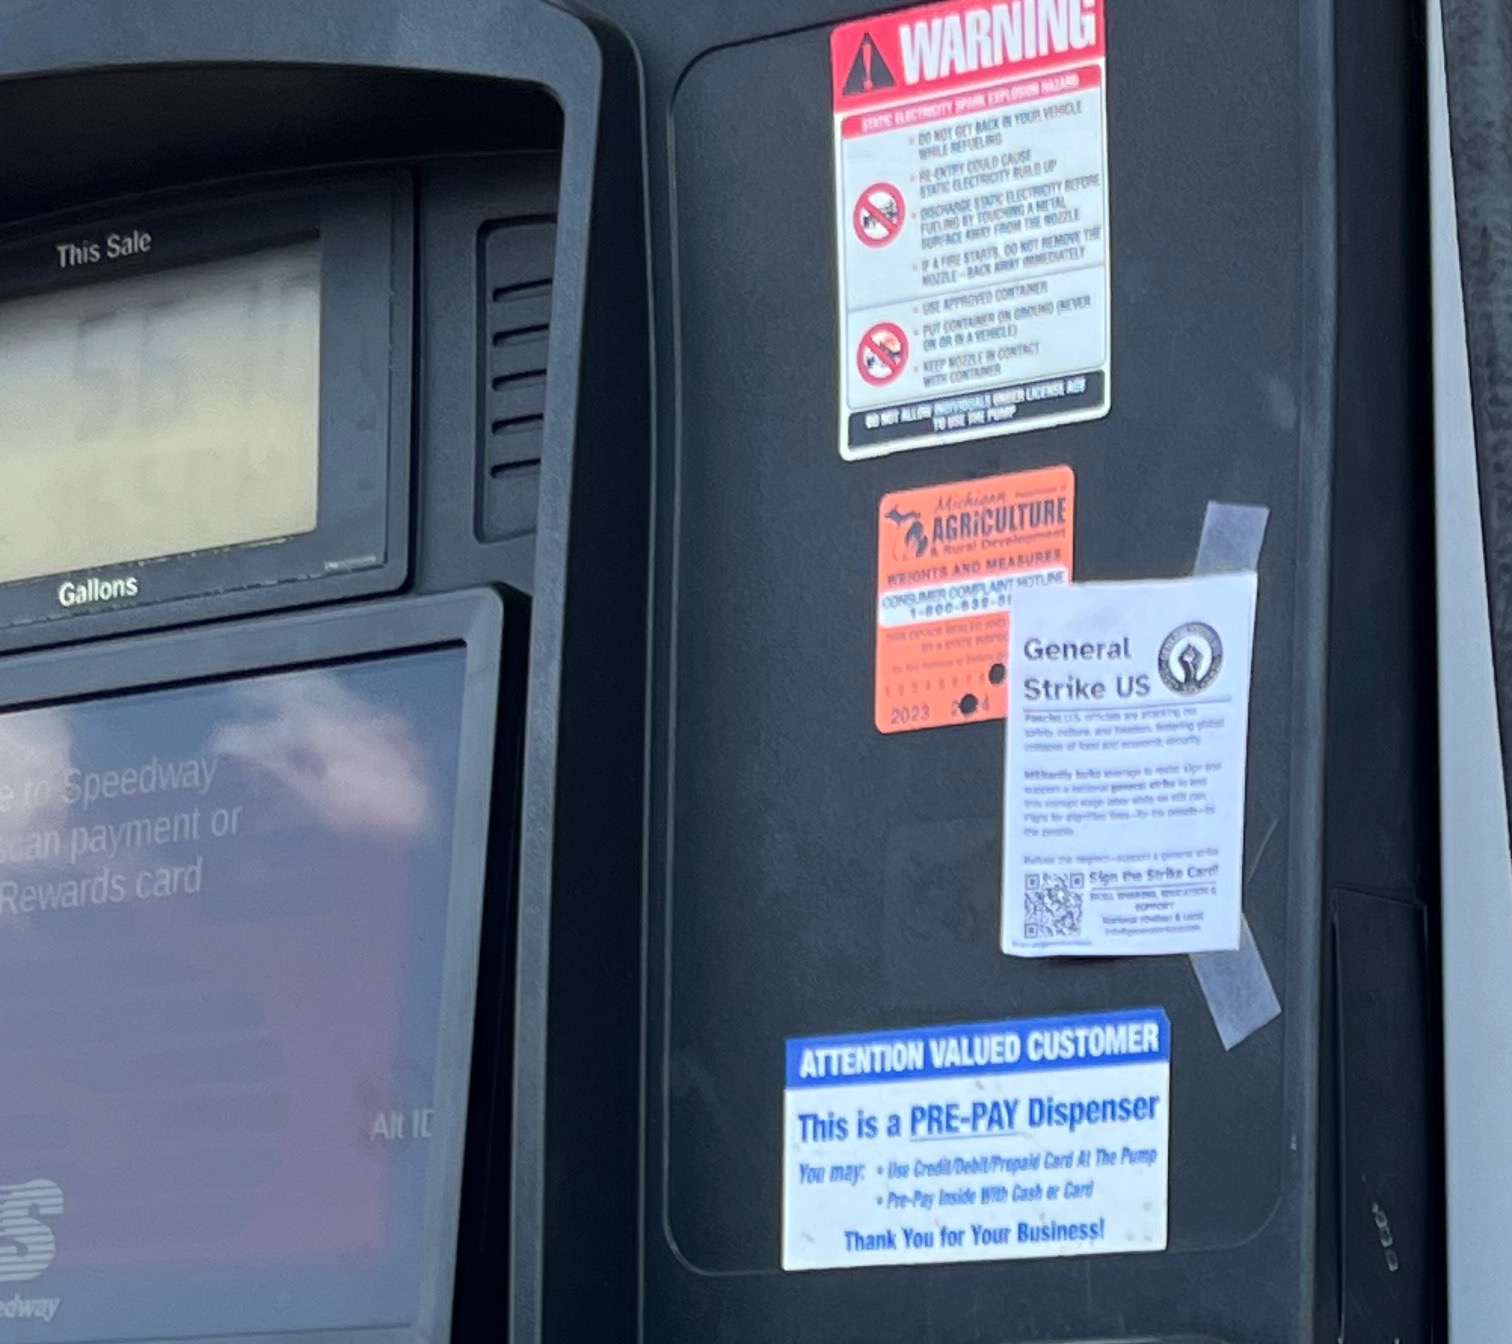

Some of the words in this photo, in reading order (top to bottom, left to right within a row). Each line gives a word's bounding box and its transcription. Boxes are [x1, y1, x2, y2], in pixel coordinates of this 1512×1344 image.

[900, 0, 1096, 85] WARNING
[56, 240, 100, 268] This
[106, 230, 151, 258] Sale
[888, 566, 948, 585] WEIGHTS
[953, 560, 980, 576] AND
[986, 549, 1061, 570] MEASURES
[58, 575, 138, 608] Gallons
[881, 589, 947, 609] CONSUMER
[948, 577, 1013, 598] COMPLAINT
[1016, 571, 1064, 587] HOTLINE
[1024, 637, 1132, 661] General
[1024, 676, 1106, 701] Strike
[1116, 675, 1151, 698] US
[891, 705, 930, 724] 2023
[61, 757, 218, 811] Speedway
[71, 808, 200, 864] payment
[210, 805, 243, 836] or
[0, 868, 127, 914] Rewards
[135, 855, 203, 899] card
[1089, 871, 1118, 886] Sign
[1123, 869, 1143, 882] the
[1147, 867, 1184, 881] Strike
[800, 1038, 924, 1078] ATTENTION
[928, 1033, 1021, 1069] VALUED
[1028, 1020, 1160, 1062] CUSTOMER
[370, 1110, 404, 1141] Alt
[798, 1112, 848, 1143] This
[858, 1110, 878, 1138] is
[887, 1116, 901, 1137] a
[910, 1099, 1020, 1136] PRE-PAY
[1029, 1095, 1160, 1132] Dispenser
[799, 1163, 824, 1183] You
[830, 1164, 866, 1186] may:
[888, 1163, 910, 1179] Use
[1046, 1151, 1074, 1169] Card
[1077, 1150, 1090, 1167] At
[1095, 1148, 1117, 1166] The
[1121, 1146, 1158, 1167] Pump
[887, 1190, 935, 1211] Pre-Pay
[939, 1188, 976, 1206] Inside
[981, 1187, 1008, 1204] With
[1012, 1184, 1042, 1201] Cash
[1047, 1186, 1059, 1199] or
[1064, 1180, 1093, 1199] Card
[845, 1229, 897, 1252] Thank
[903, 1227, 935, 1248] You
[941, 1226, 964, 1246] for
[971, 1225, 1011, 1246] Your
[1018, 1218, 1106, 1244] Business!
